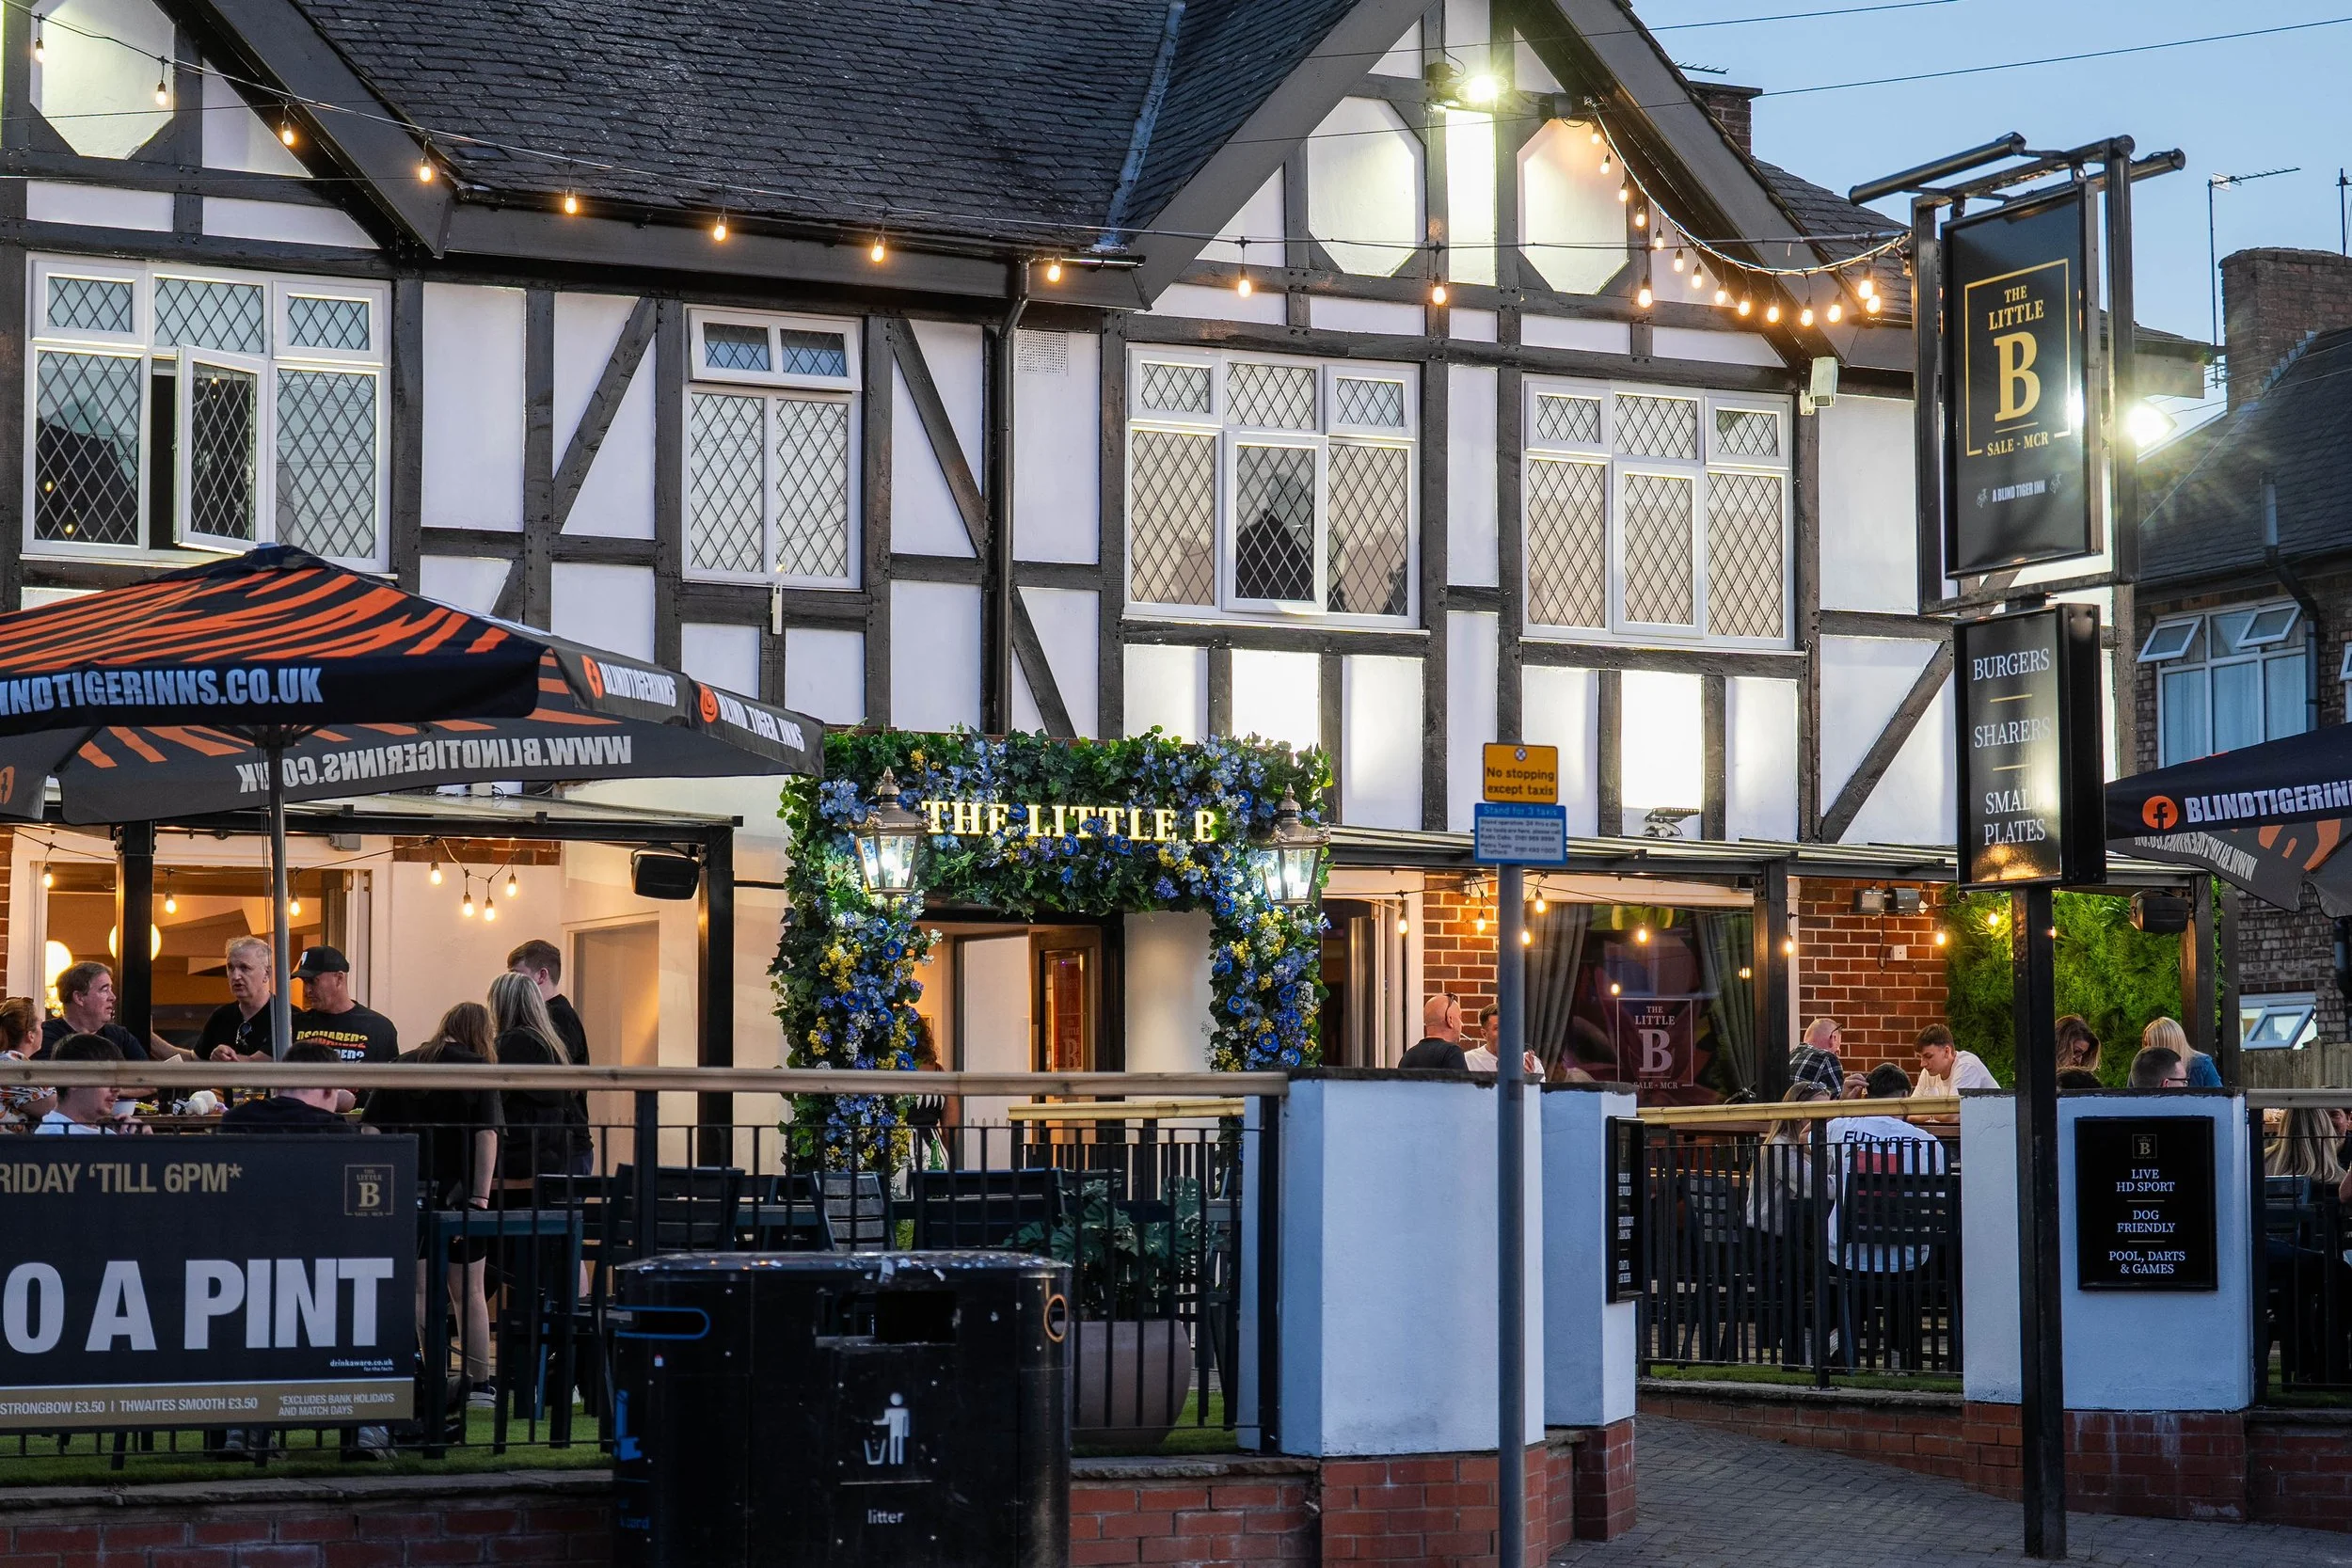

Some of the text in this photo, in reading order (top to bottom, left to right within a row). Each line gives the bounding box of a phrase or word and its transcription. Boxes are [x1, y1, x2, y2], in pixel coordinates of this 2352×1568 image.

[2004, 285, 2027, 305] THE
[1988, 299, 2044, 331] LITTLE
[1994, 331, 2042, 422] B
[1987, 438, 2014, 457] SALE
[2024, 431, 2049, 450] MCR
[2015, 482, 2033, 499] TIGER
[1973, 648, 2050, 681] BURGERS
[0, 667, 324, 716] INDTIGERINNS.CO.UK
[1974, 717, 2051, 749] SHARERS
[1486, 768, 1554, 782] No stopping
[1487, 784, 1553, 796] except taxis
[1985, 787, 2039, 815] SMAL
[2185, 780, 2352, 823] BLINDTIGERIN
[921, 800, 1219, 843] THE LITTLE B
[1983, 818, 2046, 847] PLATES
[1646, 1006, 1663, 1014] THE
[1634, 1015, 1676, 1025] LITTLE
[1638, 1029, 1673, 1072] B
[1660, 1081, 1678, 1089] MCR
[0, 1163, 81, 1194] RIDAY
[2131, 1169, 2160, 1180] LIVE
[358, 1181, 381, 1208] B
[2116, 1181, 2175, 1193] HD SPORT
[2133, 1210, 2159, 1220] DOG
[2117, 1223, 2176, 1233] FRIENDLY
[2108, 1250, 2185, 1262] POOL, DARTS
[2120, 1263, 2174, 1275] & GAMES
[85, 1260, 158, 1352] A
[183, 1258, 394, 1351] PINT
[329, 1358, 394, 1367] drinkaware.co.uk
[0, 1397, 259, 1416] STRONGBOW £3.50 THWAITES SMOOTH £3.50
[327, 1393, 352, 1403] BANK
[353, 1392, 395, 1403] HOLIDAYS
[278, 1405, 355, 1417] AND MATCH DAYS
[867, 1509, 905, 1524] litter
